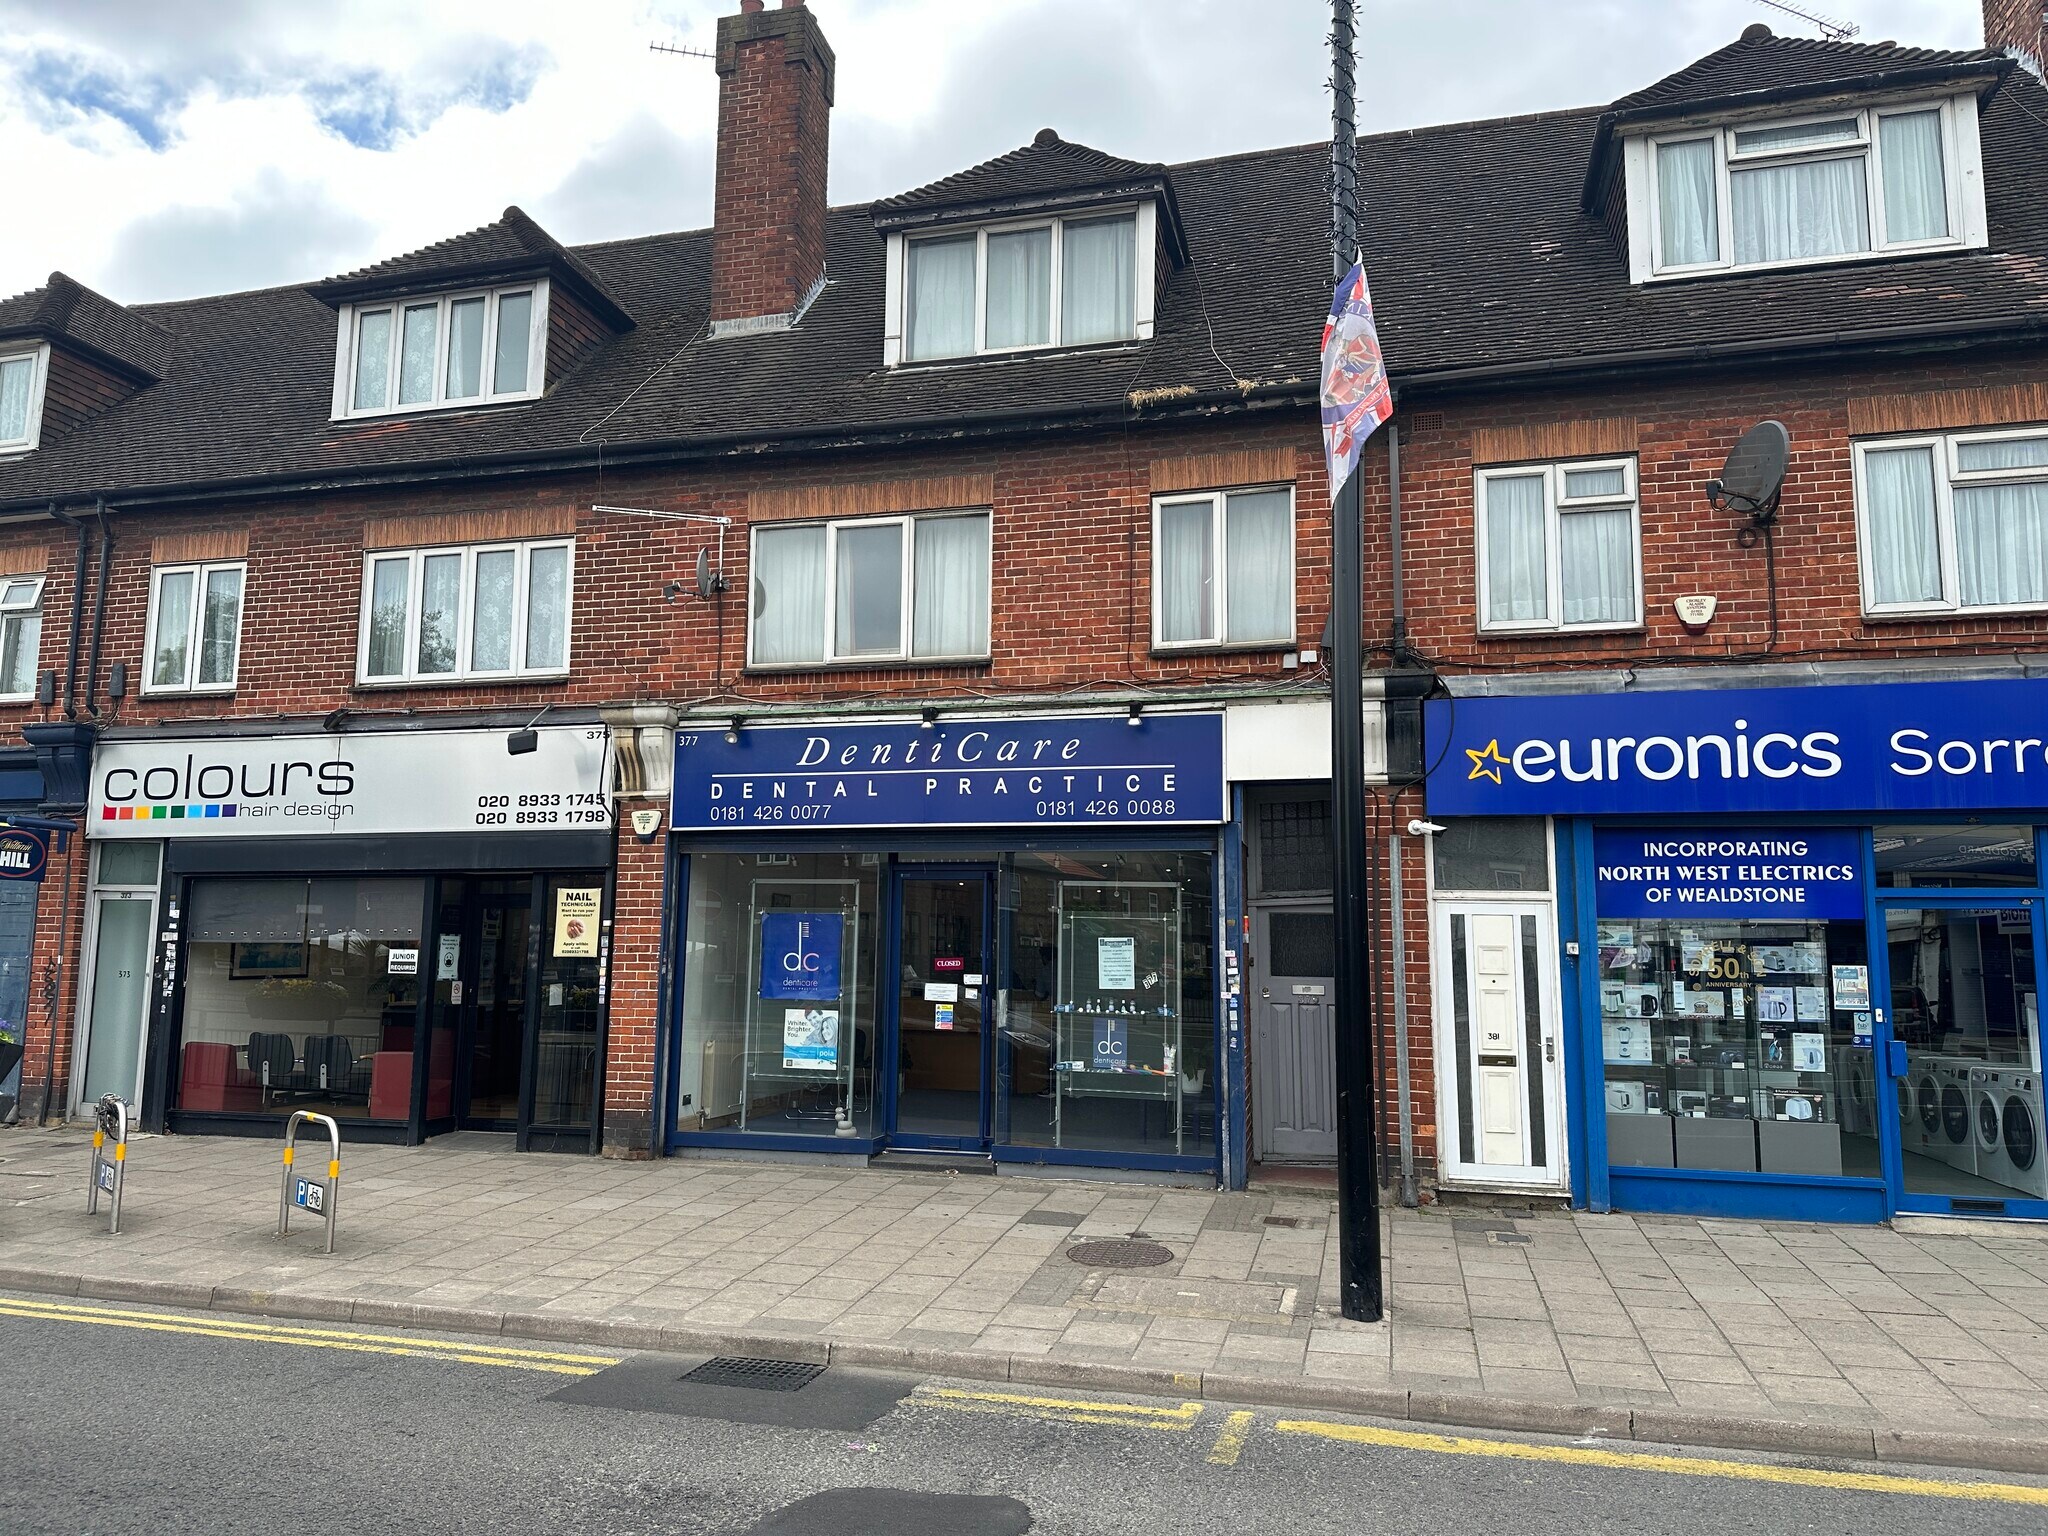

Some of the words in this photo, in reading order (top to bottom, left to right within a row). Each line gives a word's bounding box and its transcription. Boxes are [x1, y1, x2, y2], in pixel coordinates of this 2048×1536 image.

[586, 731, 610, 739] 375
[679, 736, 698, 746] 377
[796, 731, 1080, 766] DentiCare
[1512, 719, 1842, 783] euronics
[1890, 728, 2048, 776] Sorr
[104, 754, 355, 802] colours
[710, 780, 877, 800] DENTAL
[926, 774, 1176, 795] PRACTICE
[478, 796, 509, 807] 020
[518, 795, 560, 806] 8933
[566, 794, 605, 805] 1745
[1036, 801, 1075, 816] 0181
[1085, 800, 1119, 815] 426
[1127, 799, 1176, 815] 0088
[239, 803, 279, 817] hair
[283, 801, 354, 819] design
[475, 812, 507, 825] 020
[515, 811, 558, 824] 8933
[565, 810, 605, 823] 1798
[710, 806, 744, 820] 0181
[753, 805, 783, 820] 426
[790, 804, 832, 819] 0077
[1644, 841, 1808, 857] INCORPORATING
[0, 851, 30, 868] HILL
[1599, 866, 1670, 881] NORTH
[1676, 865, 1730, 881] WEST
[1738, 865, 1854, 881] ELECTRICS
[1645, 887, 1672, 903] OF
[1677, 887, 1806, 903] WEALDSTONE
[1707, 958, 1749, 979] 50th
[783, 977, 818, 986] denticare
[298, 1181, 306, 1202] P
